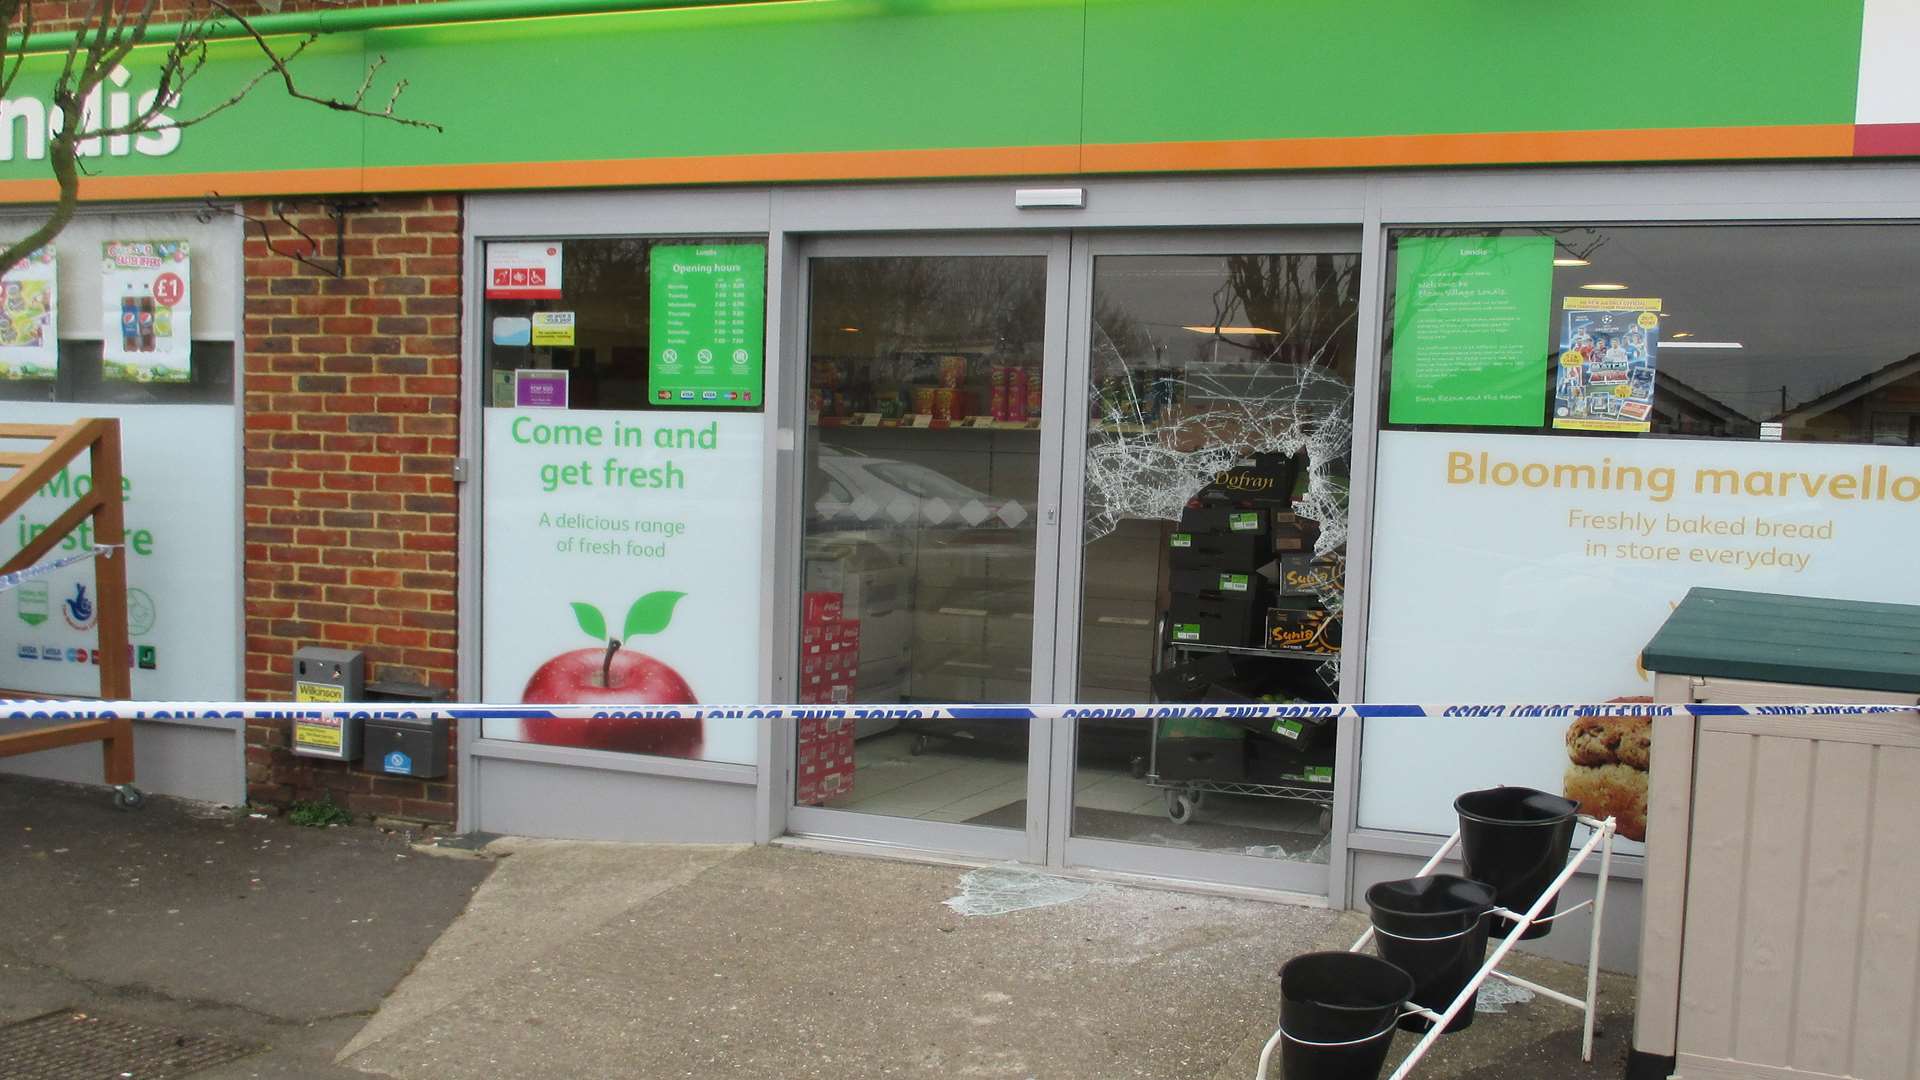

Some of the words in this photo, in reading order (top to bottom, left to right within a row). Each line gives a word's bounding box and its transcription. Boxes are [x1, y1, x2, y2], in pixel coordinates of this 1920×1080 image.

[672, 263, 712, 274] Opening
[713, 263, 741, 272] hours
[156, 278, 179, 297] £1
[511, 416, 603, 446] Come
[614, 420, 642, 447] in
[654, 421, 718, 450] and
[540, 460, 593, 491] get
[603, 458, 685, 489] fresh
[1215, 470, 1274, 491] Dofran
[1446, 451, 1676, 502] Blooming
[1694, 464, 1920, 502] marvello
[538, 512, 551, 527] A
[555, 513, 629, 531] delicious
[635, 519, 686, 537] range
[1568, 509, 1657, 537] Freshly
[1666, 515, 1745, 537] baked
[1756, 517, 1833, 540] bread
[556, 537, 575, 552] of
[579, 538, 621, 555] fresh
[627, 540, 666, 558] food
[1585, 539, 1606, 558] in
[1615, 543, 1680, 562] store
[1689, 548, 1811, 572] everyday
[299, 684, 342, 698] Wilkinson
